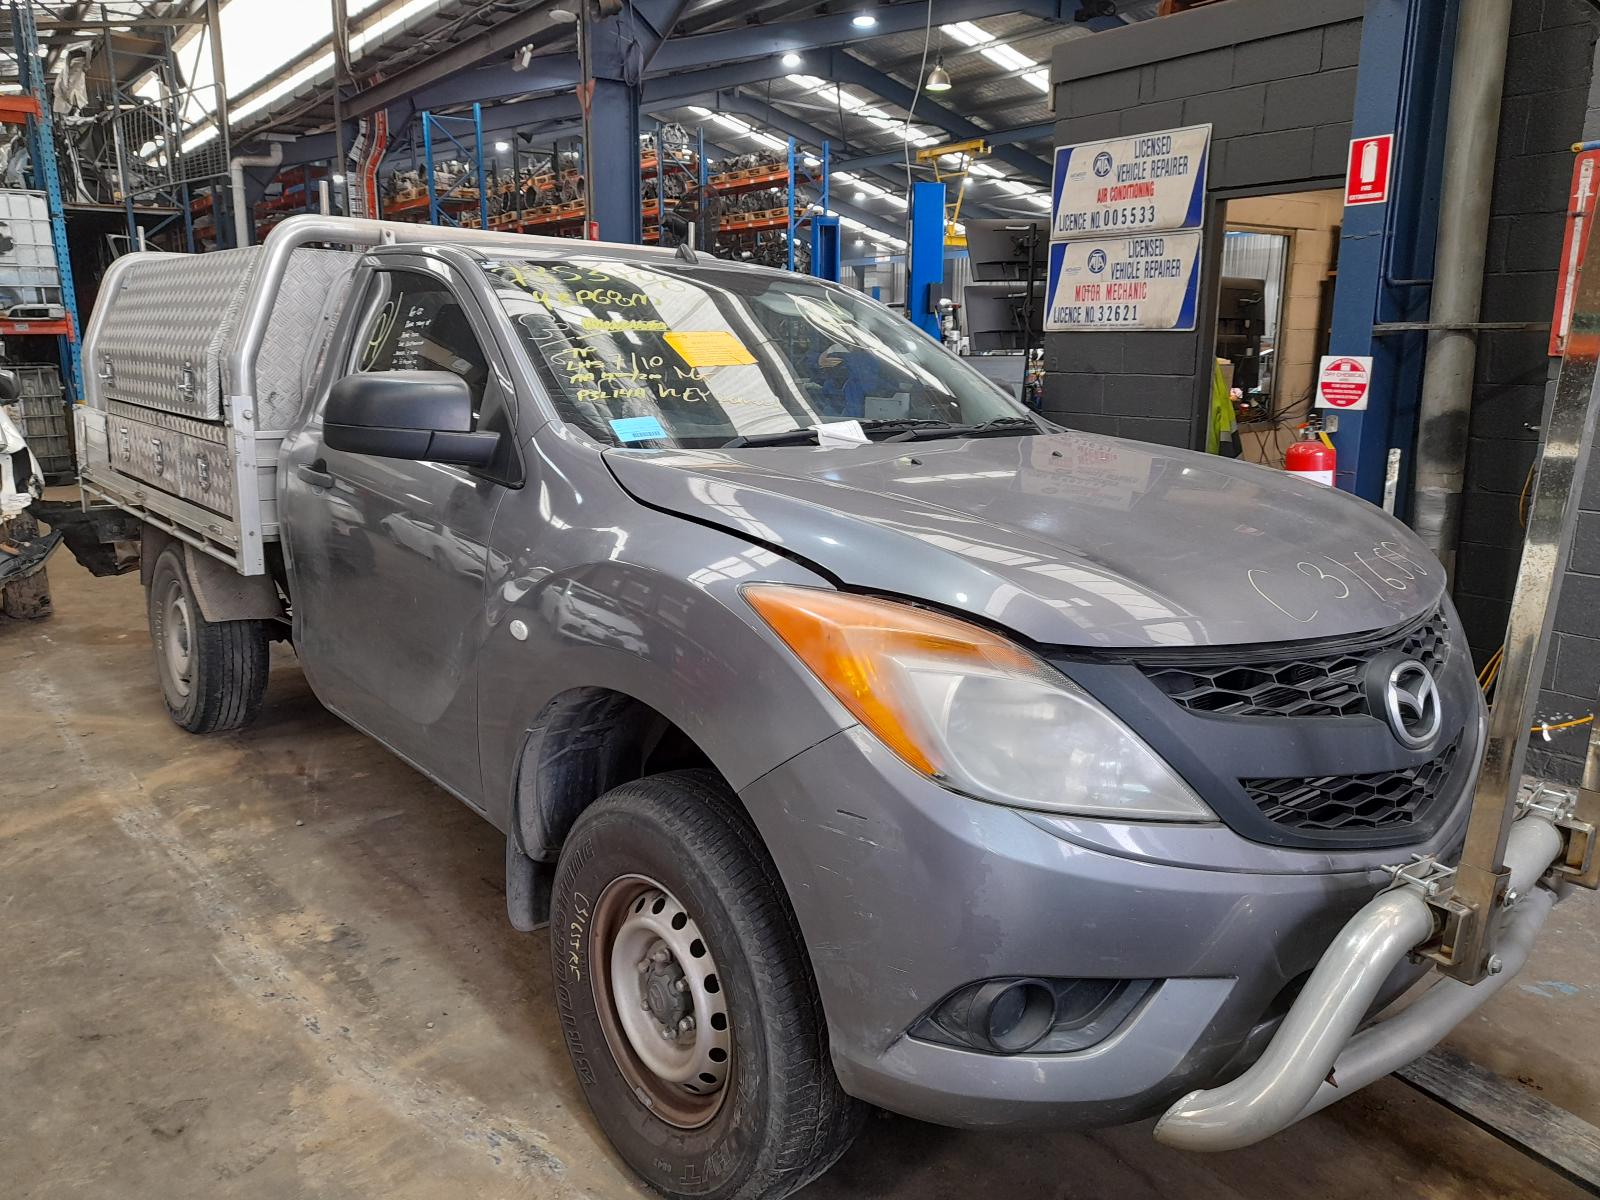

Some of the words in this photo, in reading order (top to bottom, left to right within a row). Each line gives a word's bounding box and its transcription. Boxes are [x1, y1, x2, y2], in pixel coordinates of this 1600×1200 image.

[1134, 135, 1172, 159] LICENSED
[1117, 160, 1147, 183] VEHICLE
[1150, 155, 1189, 179] REPAIRER
[1096, 187, 1107, 203] AIR
[1110, 181, 1155, 202] CONDITIONING
[1059, 212, 1087, 232] LICENCE
[1103, 205, 1156, 227] 005533
[1128, 238, 1165, 259] LICENSED
[1111, 261, 1140, 280] VEHICLE
[1144, 258, 1181, 279] REPAIRER
[1074, 284, 1101, 302] MOTOR
[1105, 281, 1148, 301] MECHANIC
[1053, 306, 1082, 324] LICENCE
[1098, 304, 1138, 322] 32621
